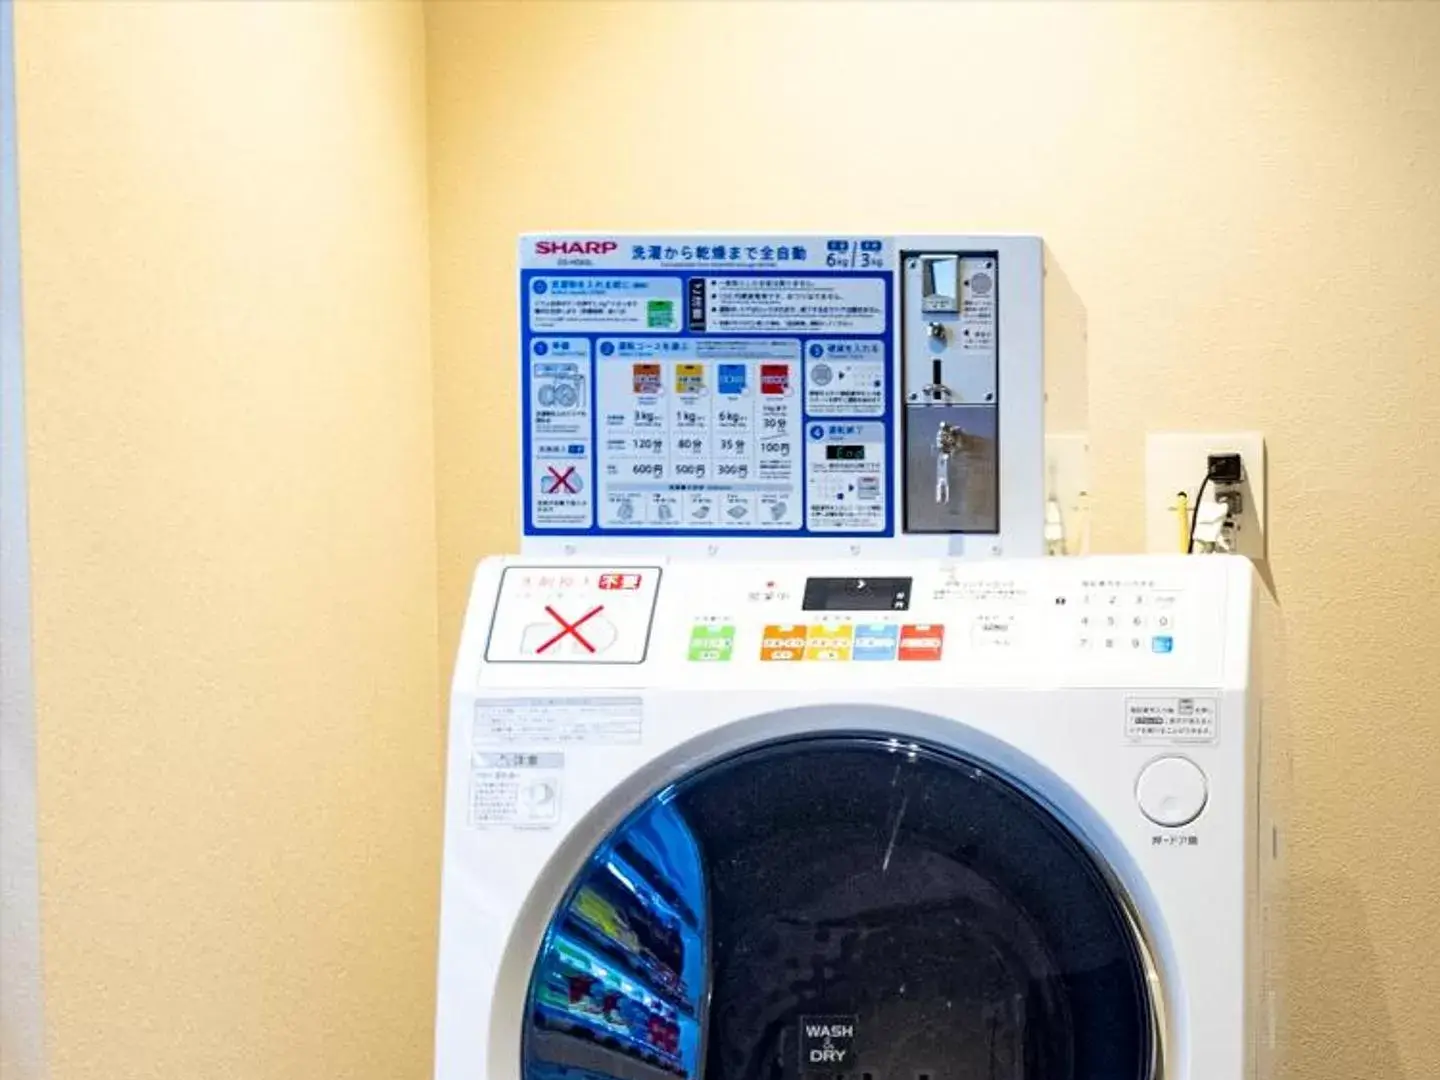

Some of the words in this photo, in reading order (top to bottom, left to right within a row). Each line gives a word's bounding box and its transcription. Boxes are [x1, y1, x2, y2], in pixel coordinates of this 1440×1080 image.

[536, 241, 617, 254] SHARP
[632, 245, 807, 260] 洗濯から乾燥まで全自動
[633, 439, 662, 449] 120分
[633, 464, 662, 474] 600円
[806, 1025, 854, 1037] WASH
[810, 1050, 846, 1062] DRY
